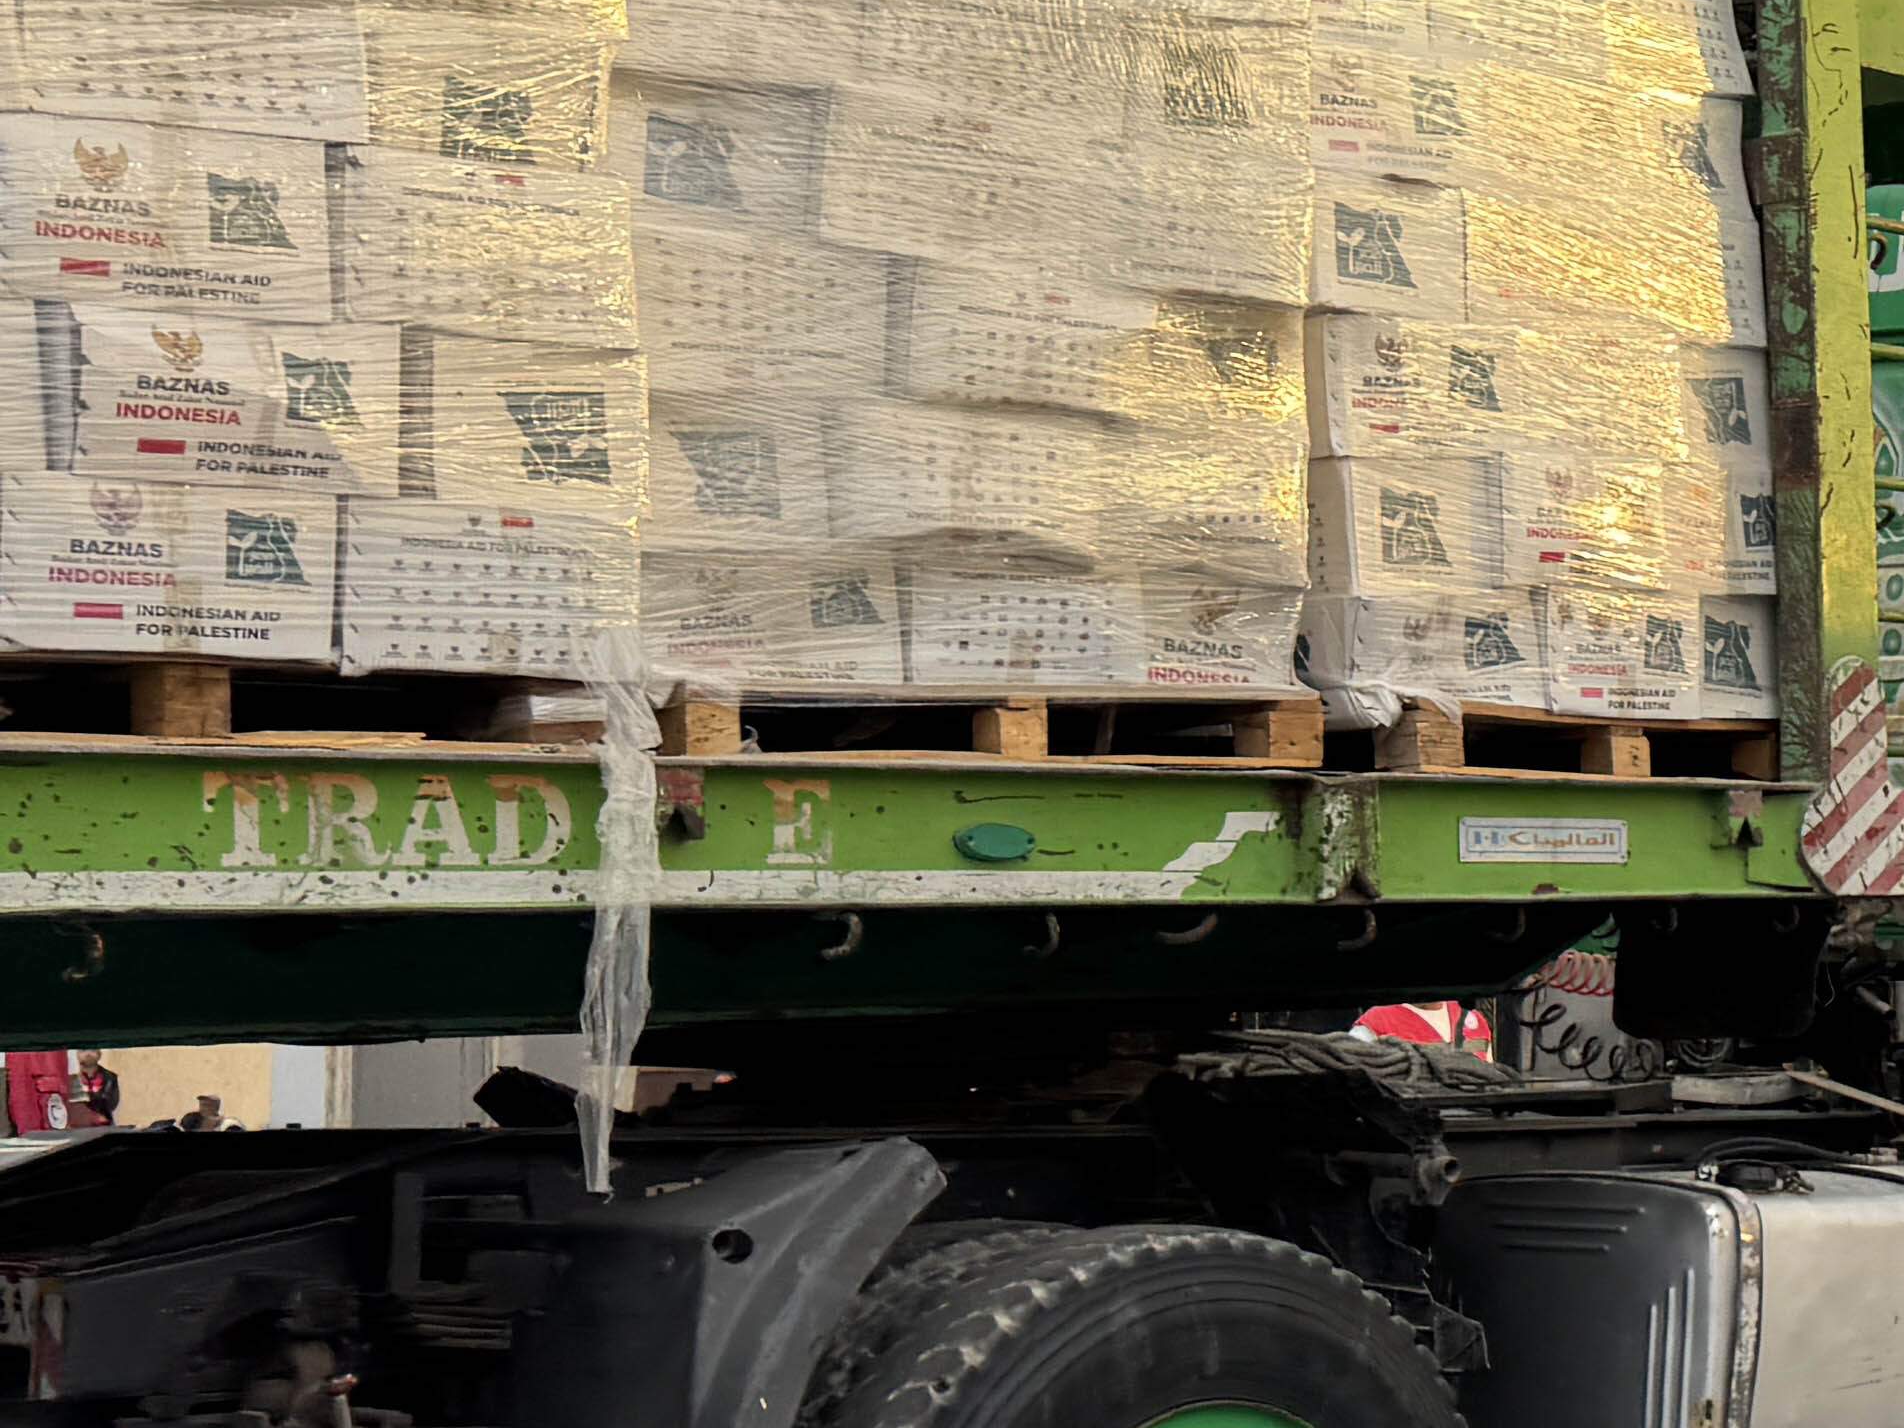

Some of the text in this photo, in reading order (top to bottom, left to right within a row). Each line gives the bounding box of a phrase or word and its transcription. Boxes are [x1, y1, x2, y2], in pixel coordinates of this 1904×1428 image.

[55, 193, 151, 217] BAZNAS
[35, 220, 167, 249] INDONESIA
[122, 263, 272, 287] INDONESIAN AID
[122, 281, 262, 305] FOR PALESTINE
[137, 374, 230, 396] BAZNAS
[115, 402, 241, 426] INDONESIA
[198, 441, 307, 460] INDONESIAN
[196, 458, 331, 478] FOR PALESTINE
[70, 538, 163, 559] BAZNAS
[49, 566, 177, 588] INDONESIA
[137, 604, 281, 622] INDONESIAN AID
[136, 623, 270, 641] FOR PALESTINE
[1163, 637, 1243, 659] BAZNAS
[1567, 663, 1628, 676] INDONESIA
[1608, 700, 1671, 711] FOR PALESTINE
